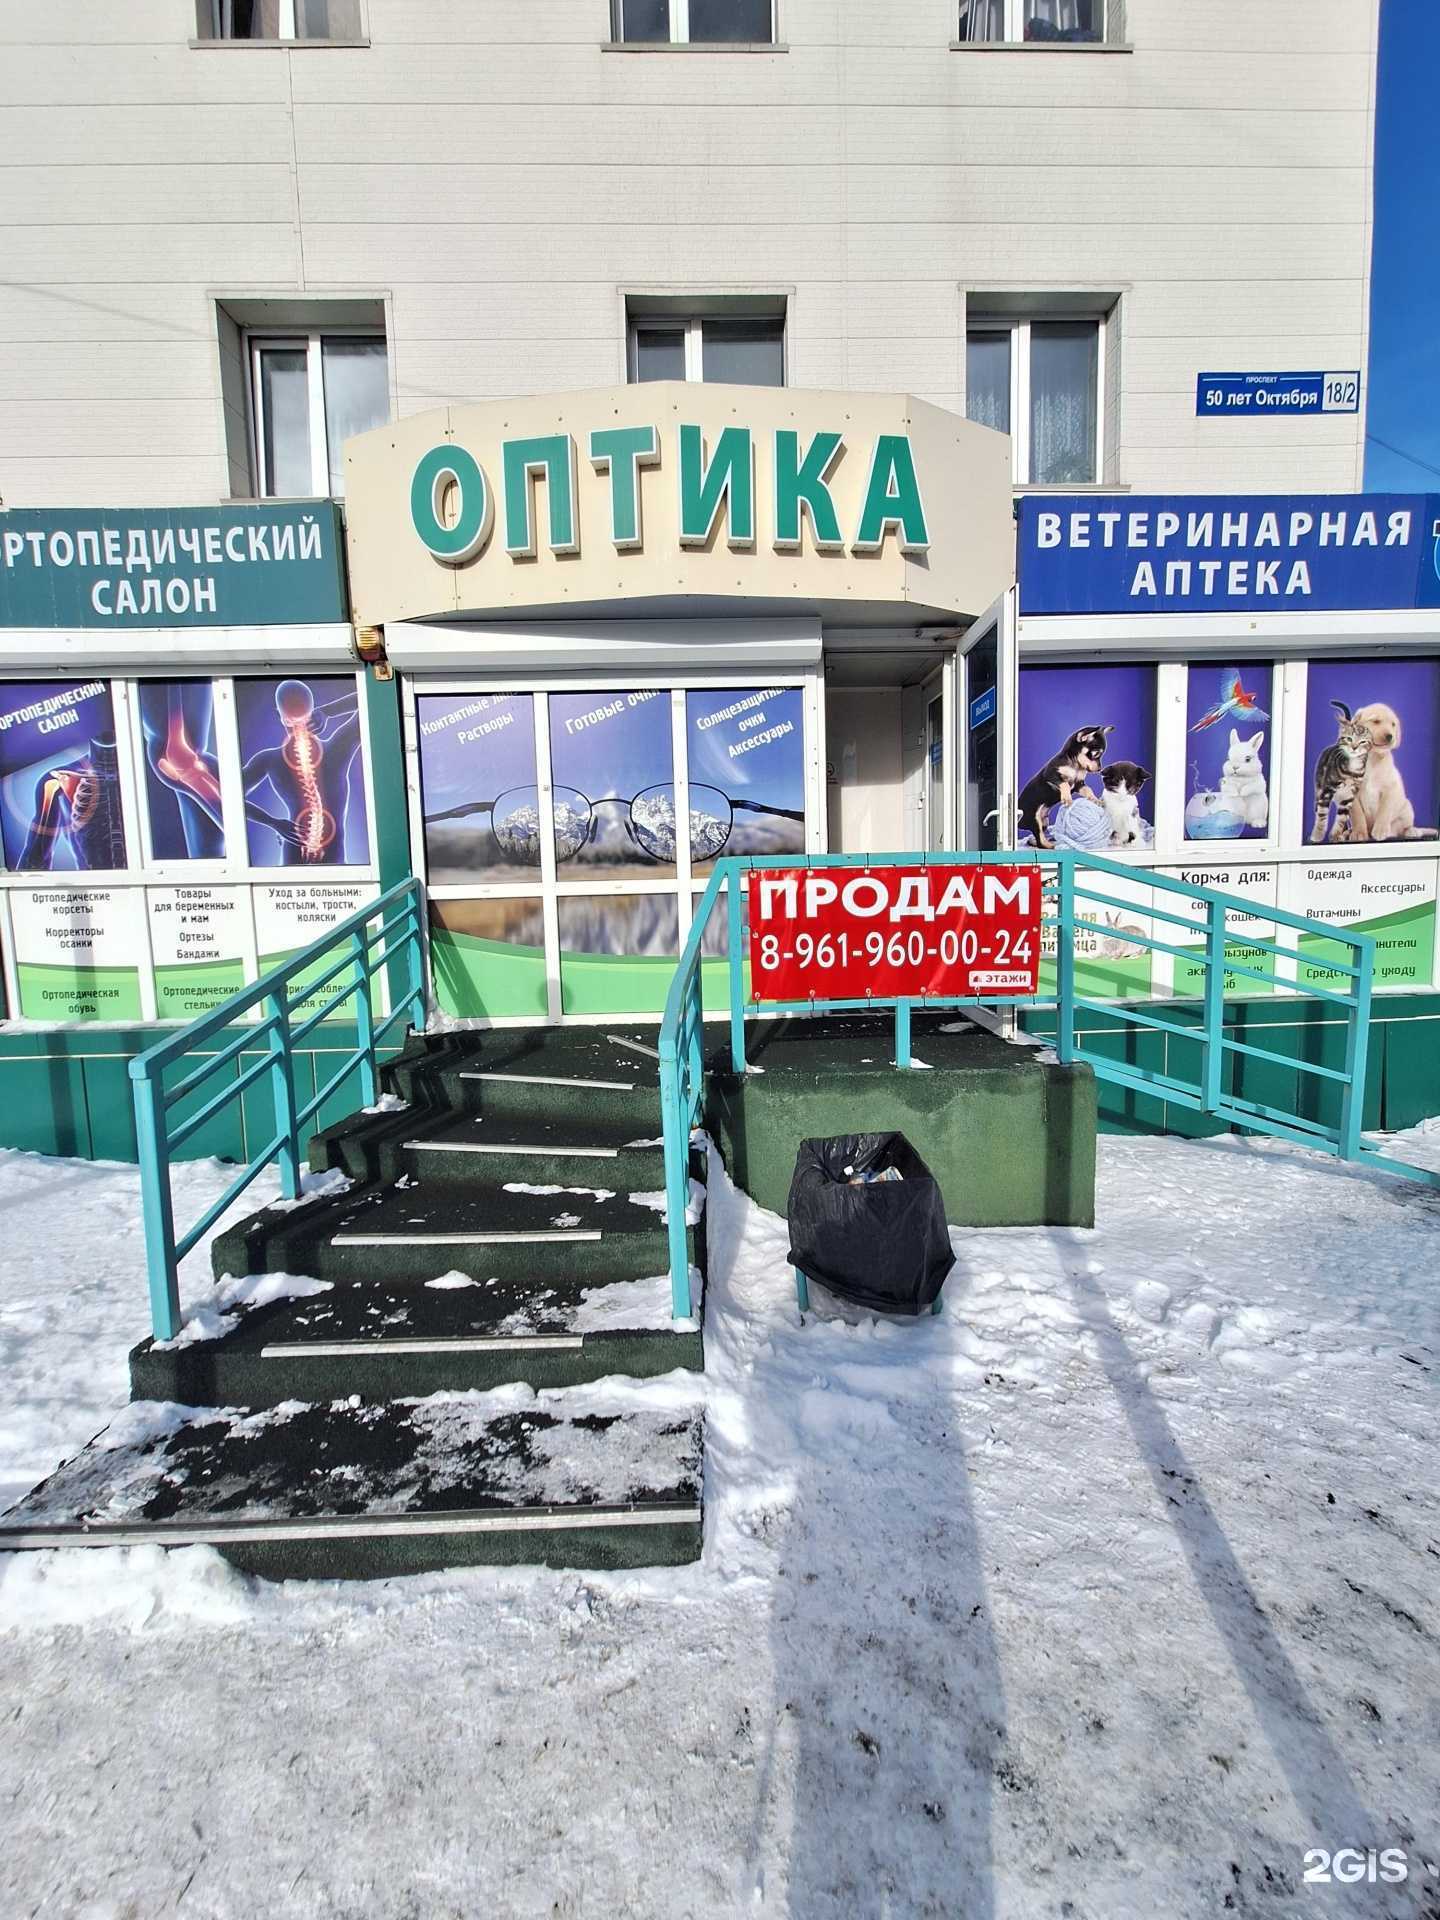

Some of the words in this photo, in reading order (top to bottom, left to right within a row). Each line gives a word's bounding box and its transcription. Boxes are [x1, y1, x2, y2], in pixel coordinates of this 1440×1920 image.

[1245, 376, 1278, 384] ПРОСПЕКТ
[1206, 390, 1223, 406] 50
[1227, 391, 1252, 405] лет
[1255, 389, 1318, 408] Октября
[1326, 382, 1356, 404] 18/2
[410, 424, 931, 564] ОПТИКА
[1037, 511, 1411, 548] ВЕТЕРИНАРНАЯ
[0, 515, 322, 573] РТОПЕДИЧЕСКИЙ
[1130, 560, 1311, 596] АПТЕКА
[91, 577, 217, 615] САЛОН
[38, 709, 79, 734] САЛОН
[420, 698, 490, 737] Контактные
[565, 699, 625, 735] Готовые
[738, 712, 767, 732] очки
[457, 712, 514, 745] Растворы
[728, 720, 794, 758] Аксессуары
[1181, 871, 1229, 886] Корма
[1238, 872, 1270, 884] для:
[1307, 869, 1352, 880] Одежда
[175, 888, 211, 899] Товары
[269, 888, 292, 898] Уход
[296, 889, 306, 898] за
[310, 887, 362, 897] больными:
[1361, 883, 1425, 895] Аксессуары
[32, 892, 110, 904] Ортопедические
[759, 875, 1030, 922] ПРОДАМ
[53, 904, 93, 915] корсеты
[154, 902, 171, 912] для
[175, 901, 235, 912] беременных
[275, 901, 319, 910] костыли,
[323, 900, 357, 910] трости,
[181, 915, 187, 923] и
[191, 914, 209, 923] мам
[297, 914, 336, 922] коляски
[1306, 908, 1361, 918] Витамины
[45, 927, 104, 938] Корректоры
[179, 932, 215, 943] Ортезы
[60, 940, 92, 949] осанки
[760, 929, 1032, 970] 8-961-960-00-24
[176, 949, 220, 960] Бандажи
[1382, 967, 1415, 977] уходу
[985, 974, 1027, 983] этажи
[42, 989, 119, 1001] Ортопедическая
[163, 985, 240, 997] Ортопедические
[68, 1003, 96, 1014] обувь
